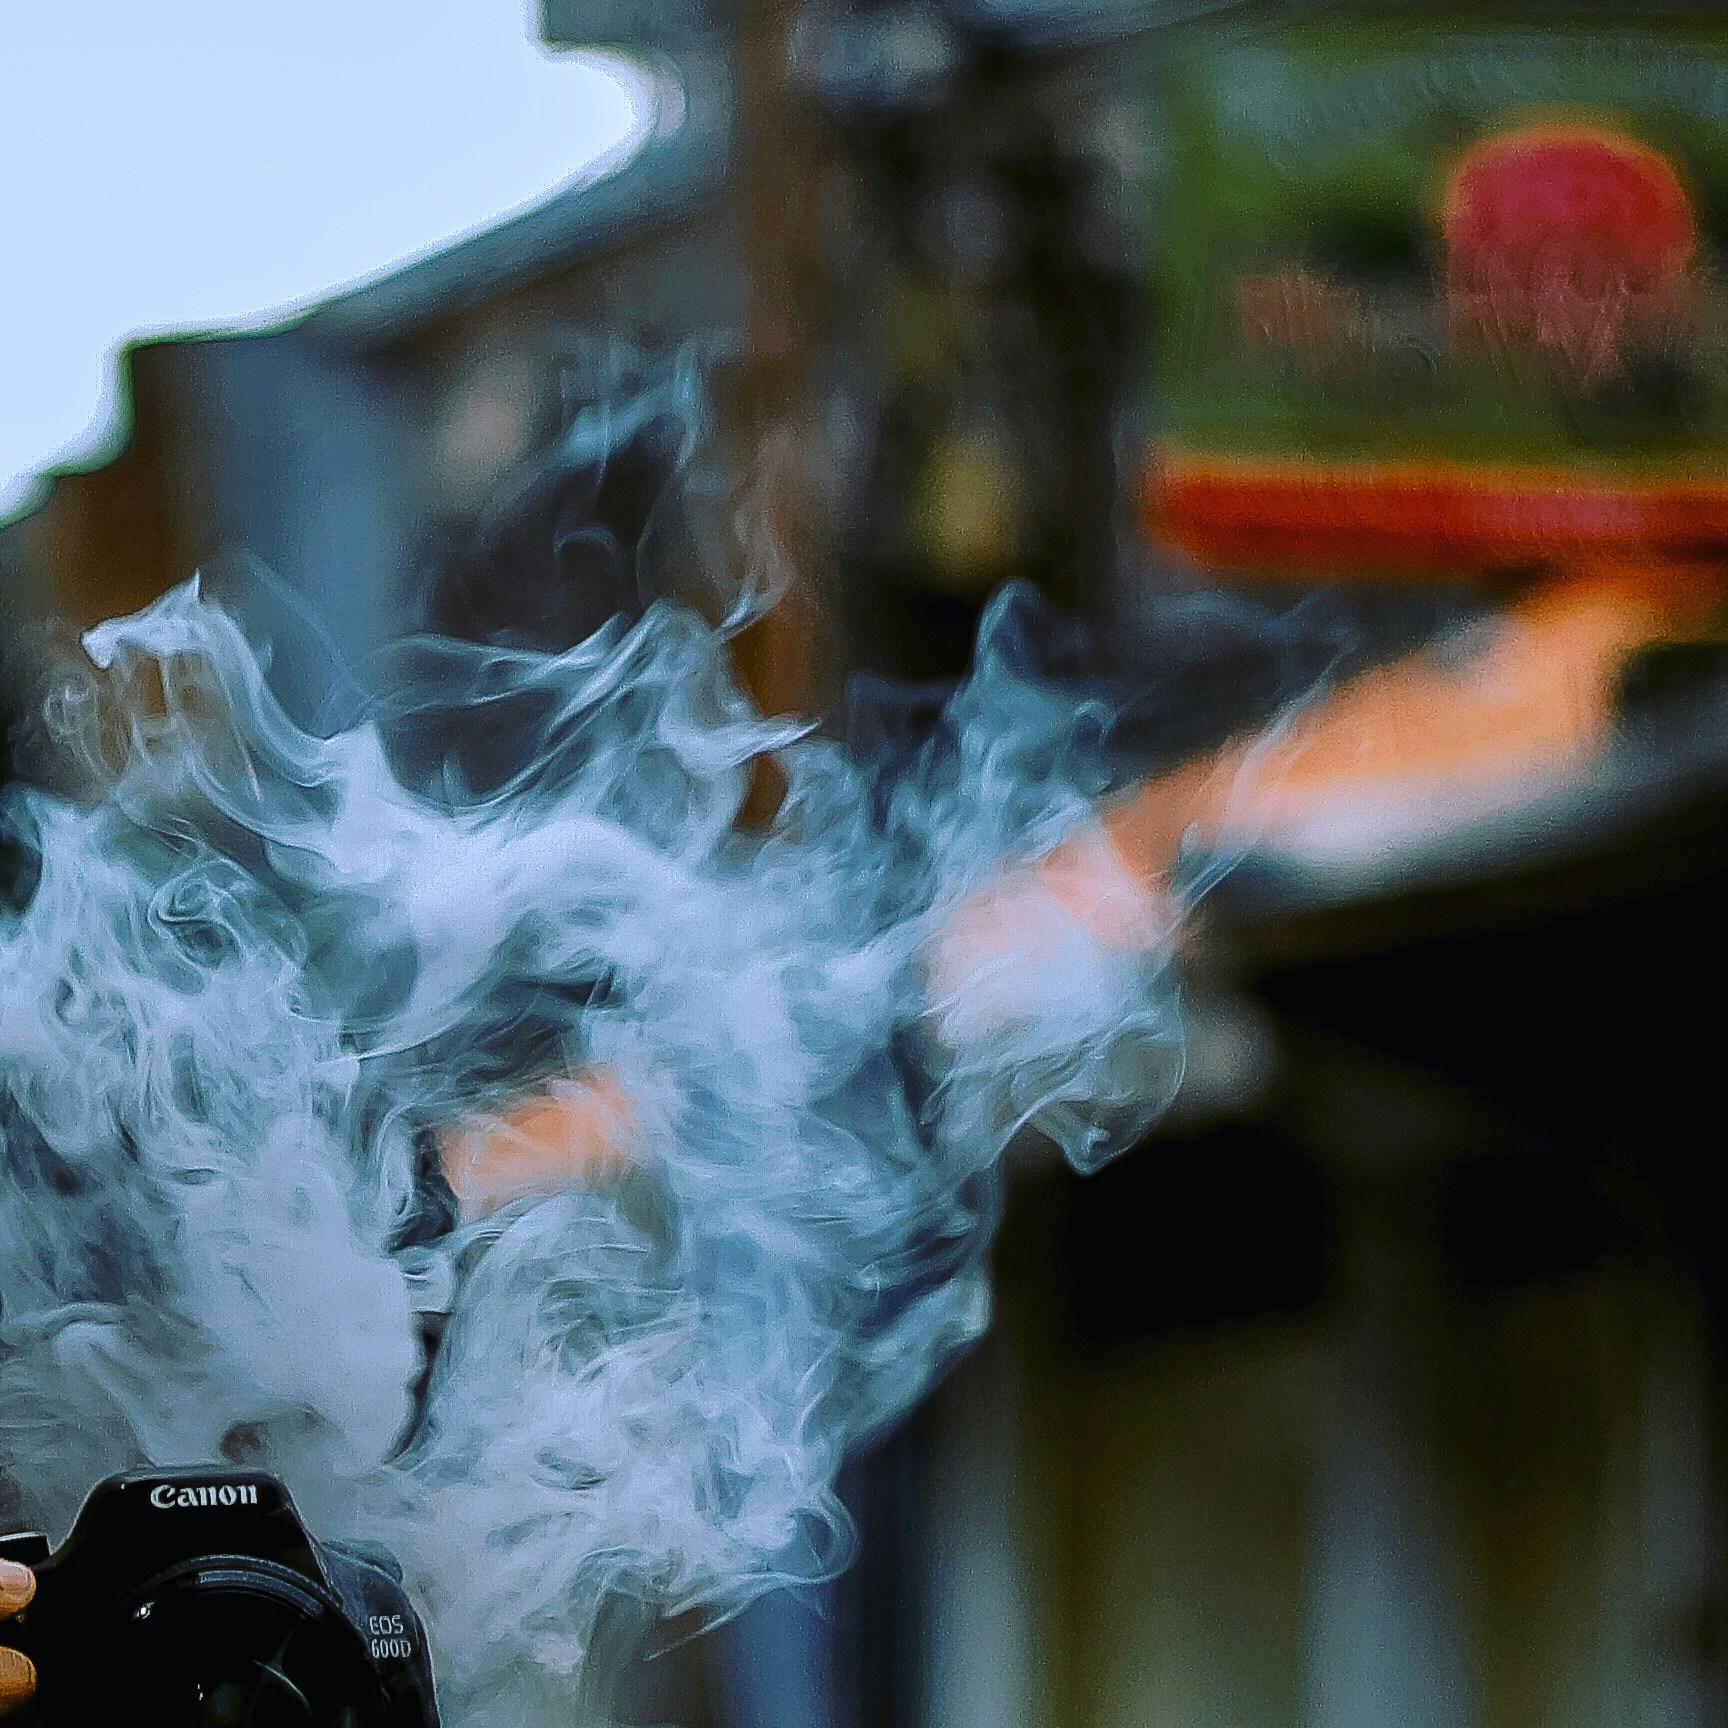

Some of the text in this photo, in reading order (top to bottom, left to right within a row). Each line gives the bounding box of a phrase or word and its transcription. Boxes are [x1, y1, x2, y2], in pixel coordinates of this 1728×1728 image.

[150, 1484, 258, 1509] Canon
[369, 1614, 404, 1635] EOS
[371, 1638, 412, 1659] 600D
